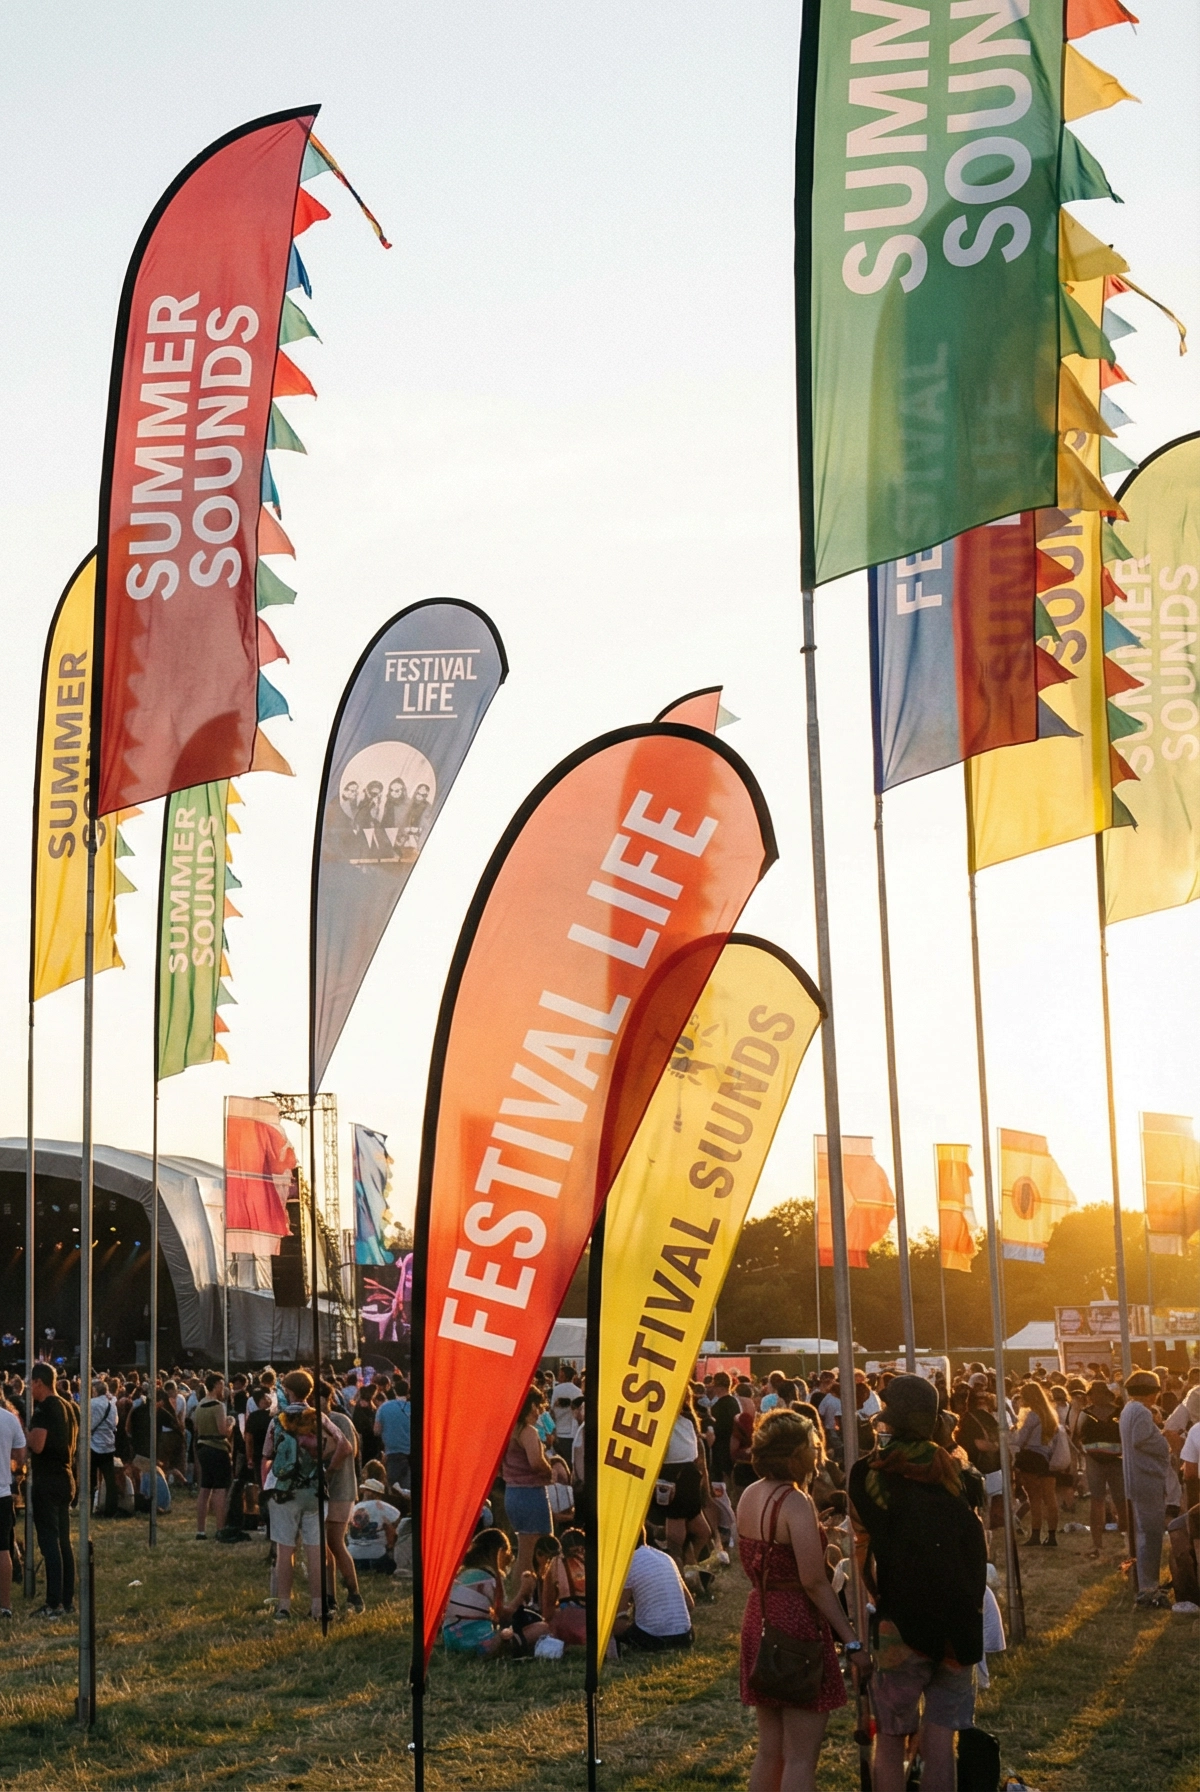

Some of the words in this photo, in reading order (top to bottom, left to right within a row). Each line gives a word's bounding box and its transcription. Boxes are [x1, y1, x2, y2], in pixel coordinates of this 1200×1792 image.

[125, 290, 200, 602] SUMMER
[188, 303, 259, 590] SOUNDS
[47, 649, 88, 859] SUMMER
[385, 656, 478, 682] FESTIVAL
[402, 682, 455, 713] LIFE
[1159, 563, 1200, 761] SOUNDS
[168, 806, 197, 974] SUMMER
[191, 815, 218, 968] SOUNDS
[436, 989, 632, 1358] FESTIVAL
[567, 789, 720, 969] LIFE
[603, 1212, 721, 1481] FESTIVAL
